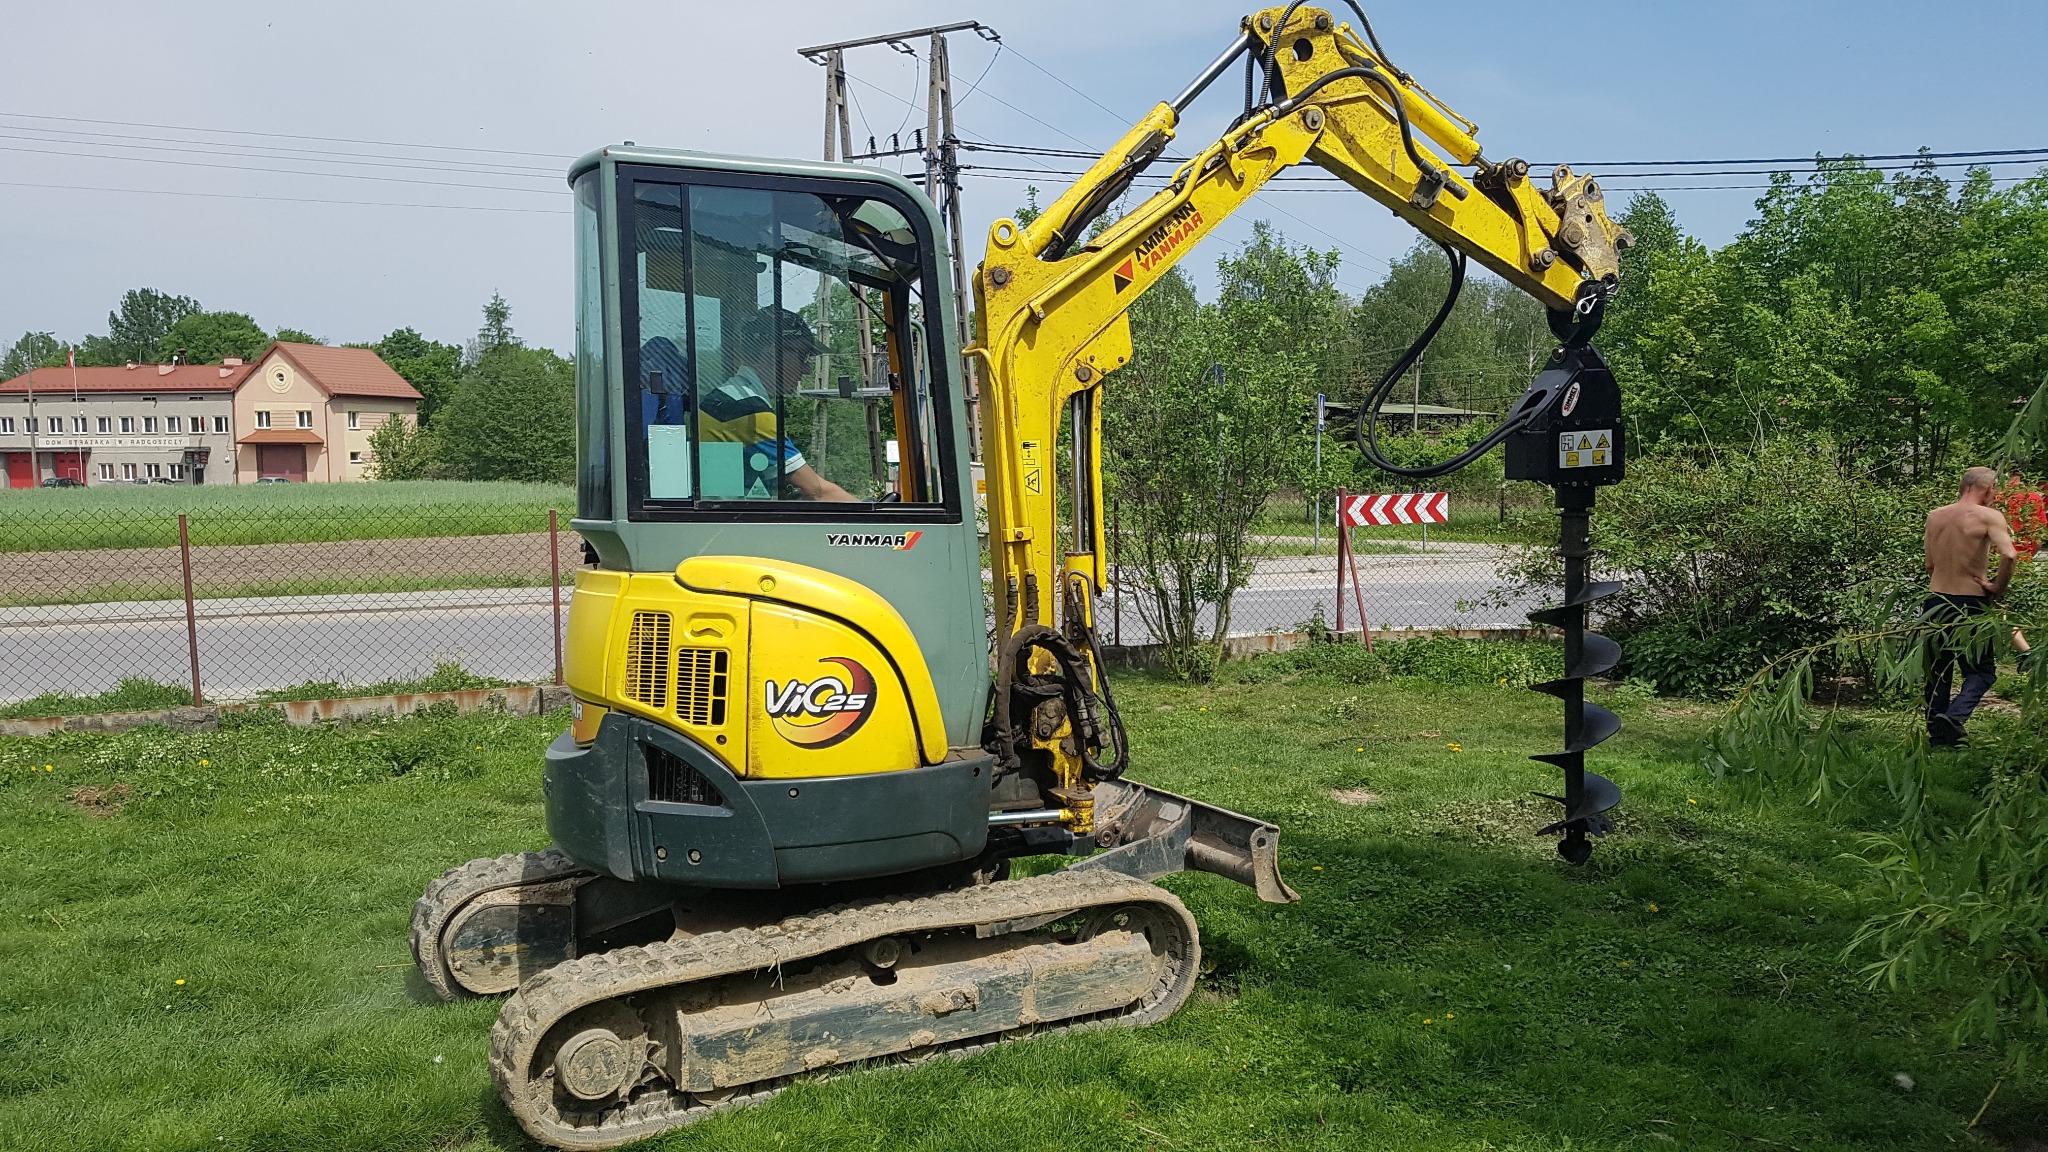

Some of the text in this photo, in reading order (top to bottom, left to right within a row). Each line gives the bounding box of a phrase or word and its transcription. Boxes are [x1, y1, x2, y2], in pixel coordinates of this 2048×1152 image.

[1134, 200, 1197, 262] AMMANN
[1139, 211, 1204, 272] YANMAR
[826, 534, 907, 546] YANMAR
